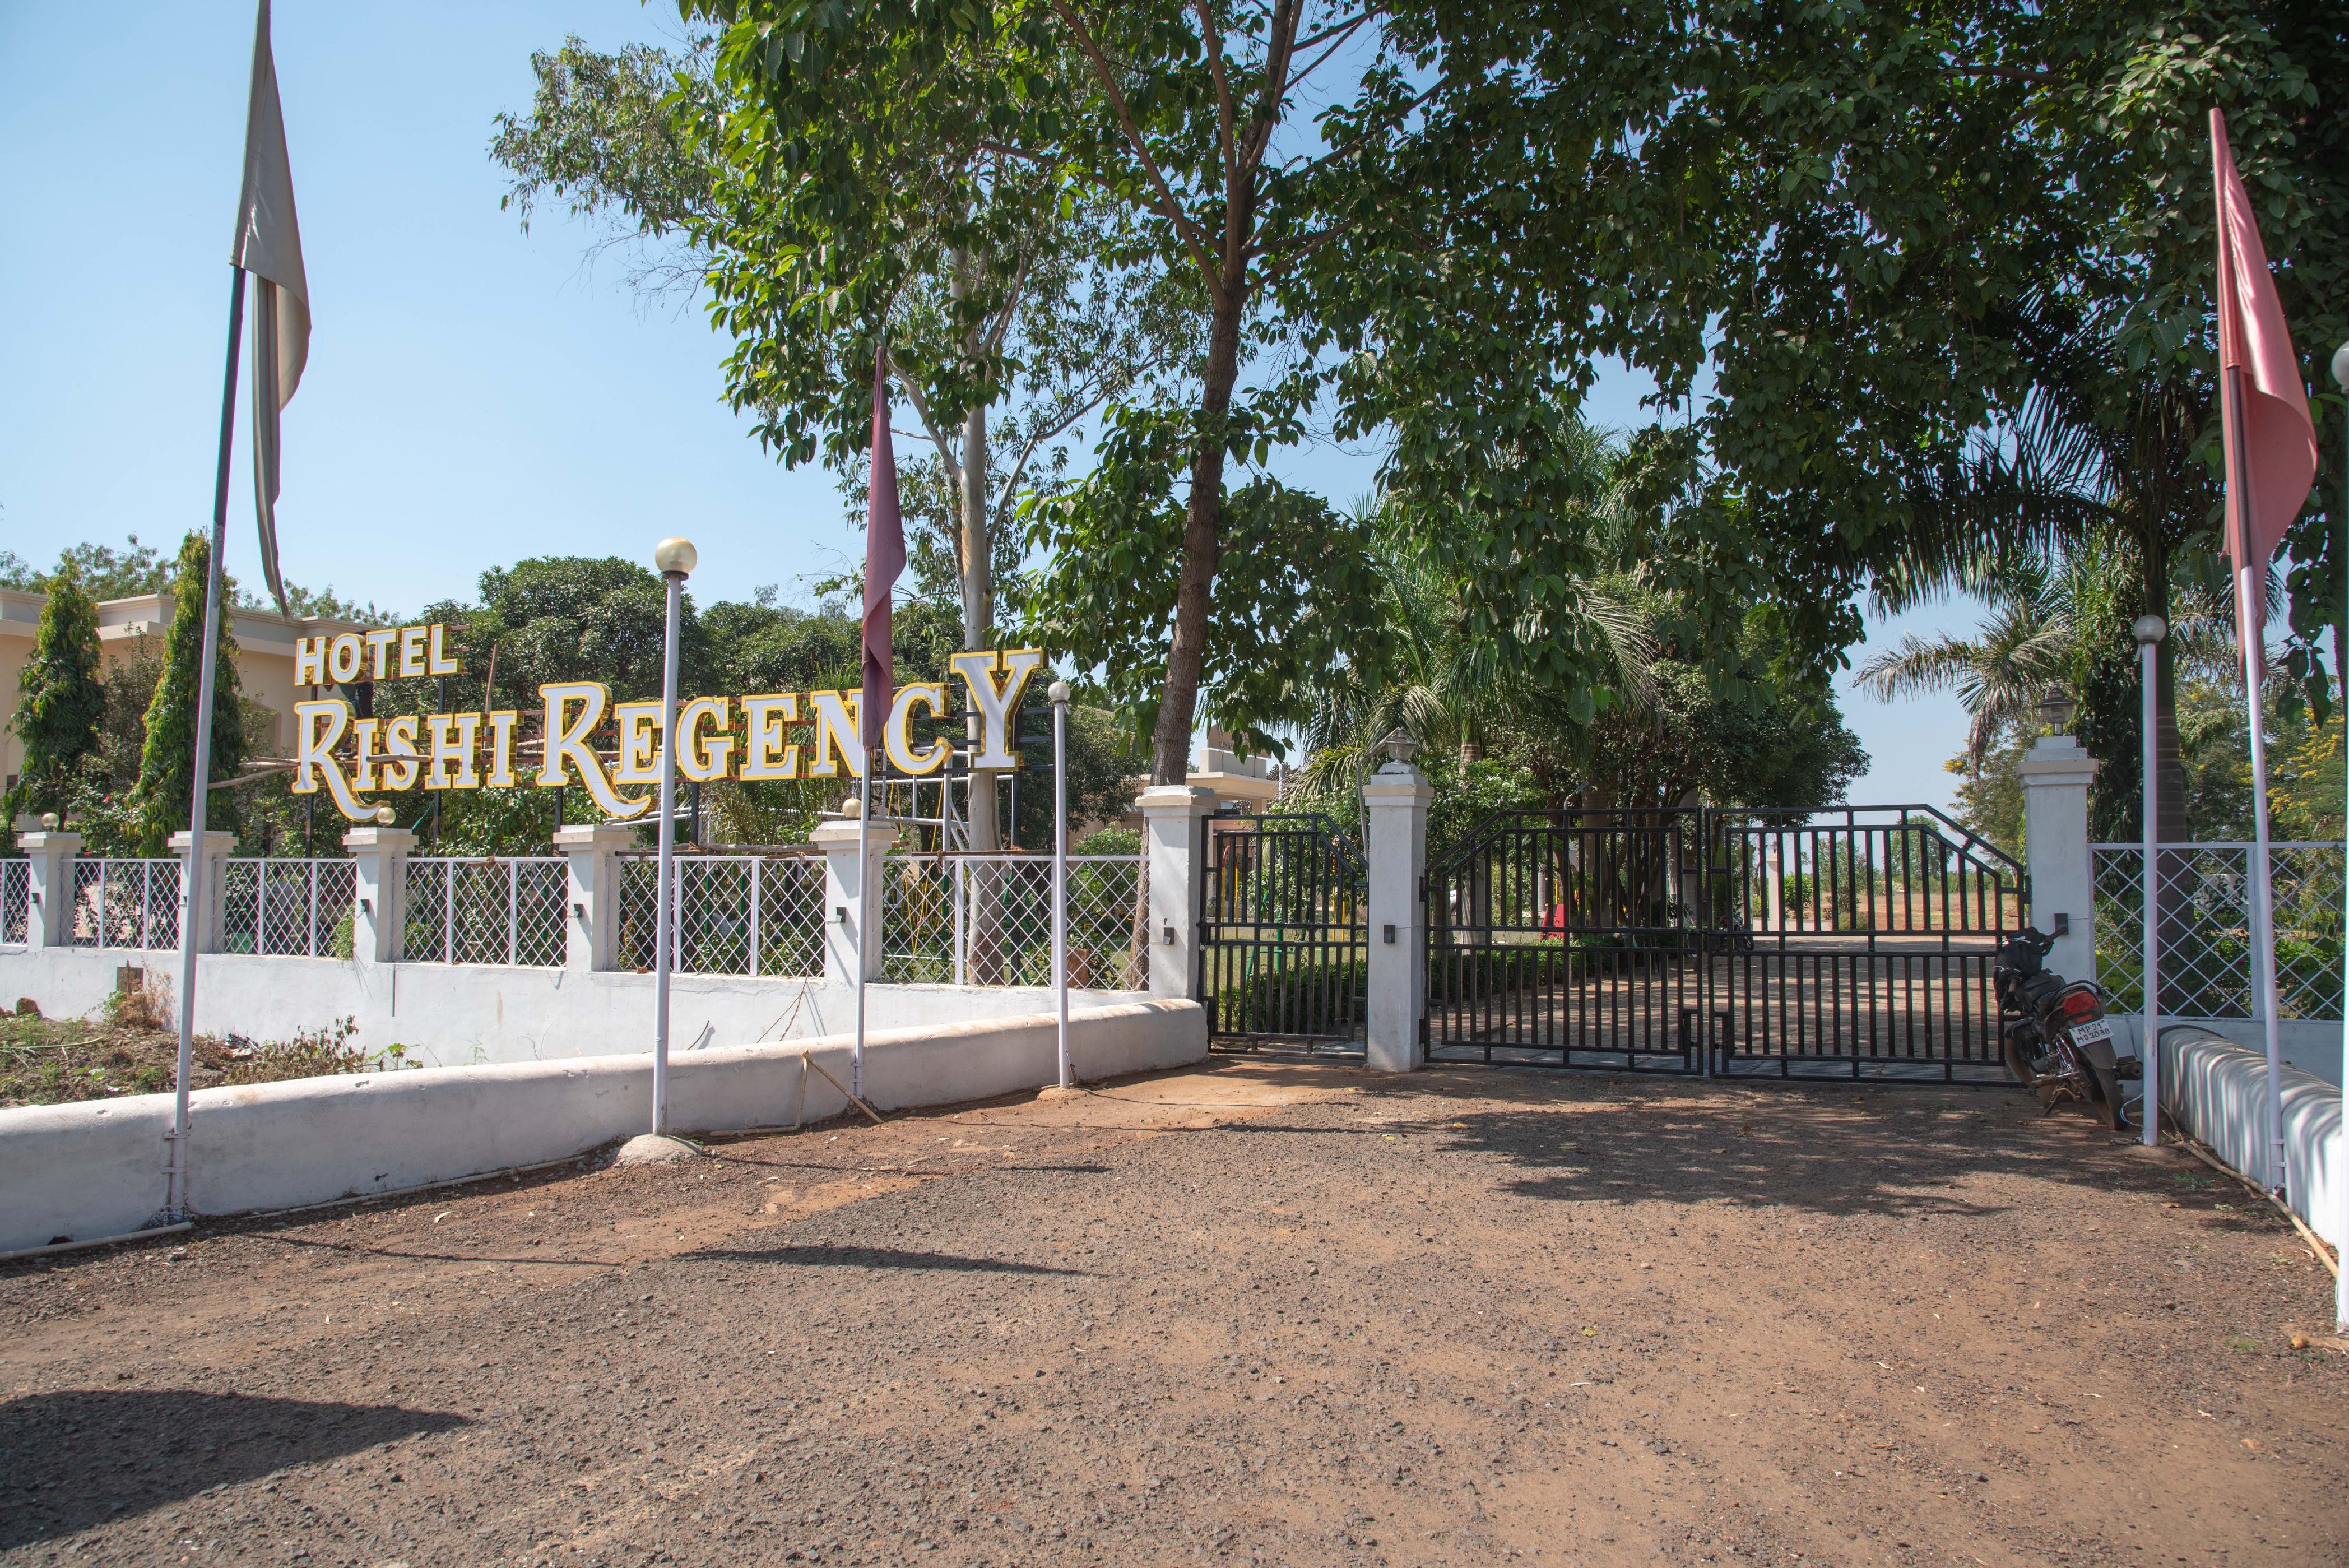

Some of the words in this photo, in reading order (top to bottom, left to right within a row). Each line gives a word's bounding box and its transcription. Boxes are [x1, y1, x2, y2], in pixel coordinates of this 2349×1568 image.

[294, 623, 463, 686] HOTEL
[291, 699, 519, 823] RISHI
[536, 648, 1047, 818] REGENCY
[2077, 1026, 2090, 1034] MP
